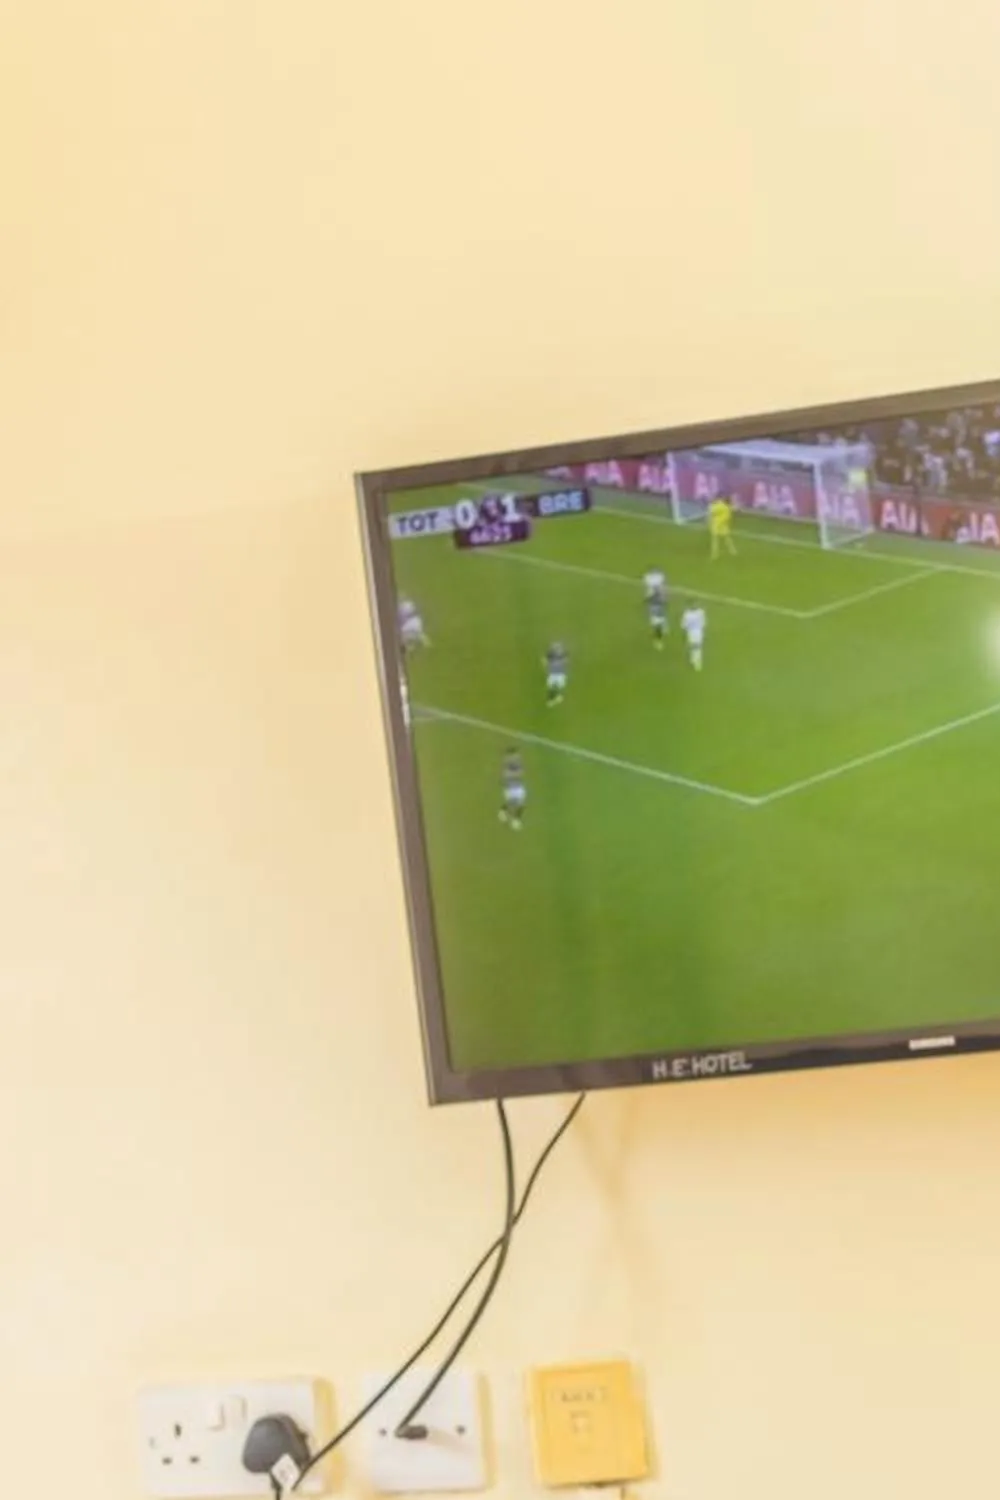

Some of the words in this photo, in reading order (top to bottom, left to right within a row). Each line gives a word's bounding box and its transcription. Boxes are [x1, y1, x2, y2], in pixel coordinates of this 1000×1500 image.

[395, 511, 439, 535] TOT
[455, 500, 476, 530] 0
[502, 494, 523, 523] 1
